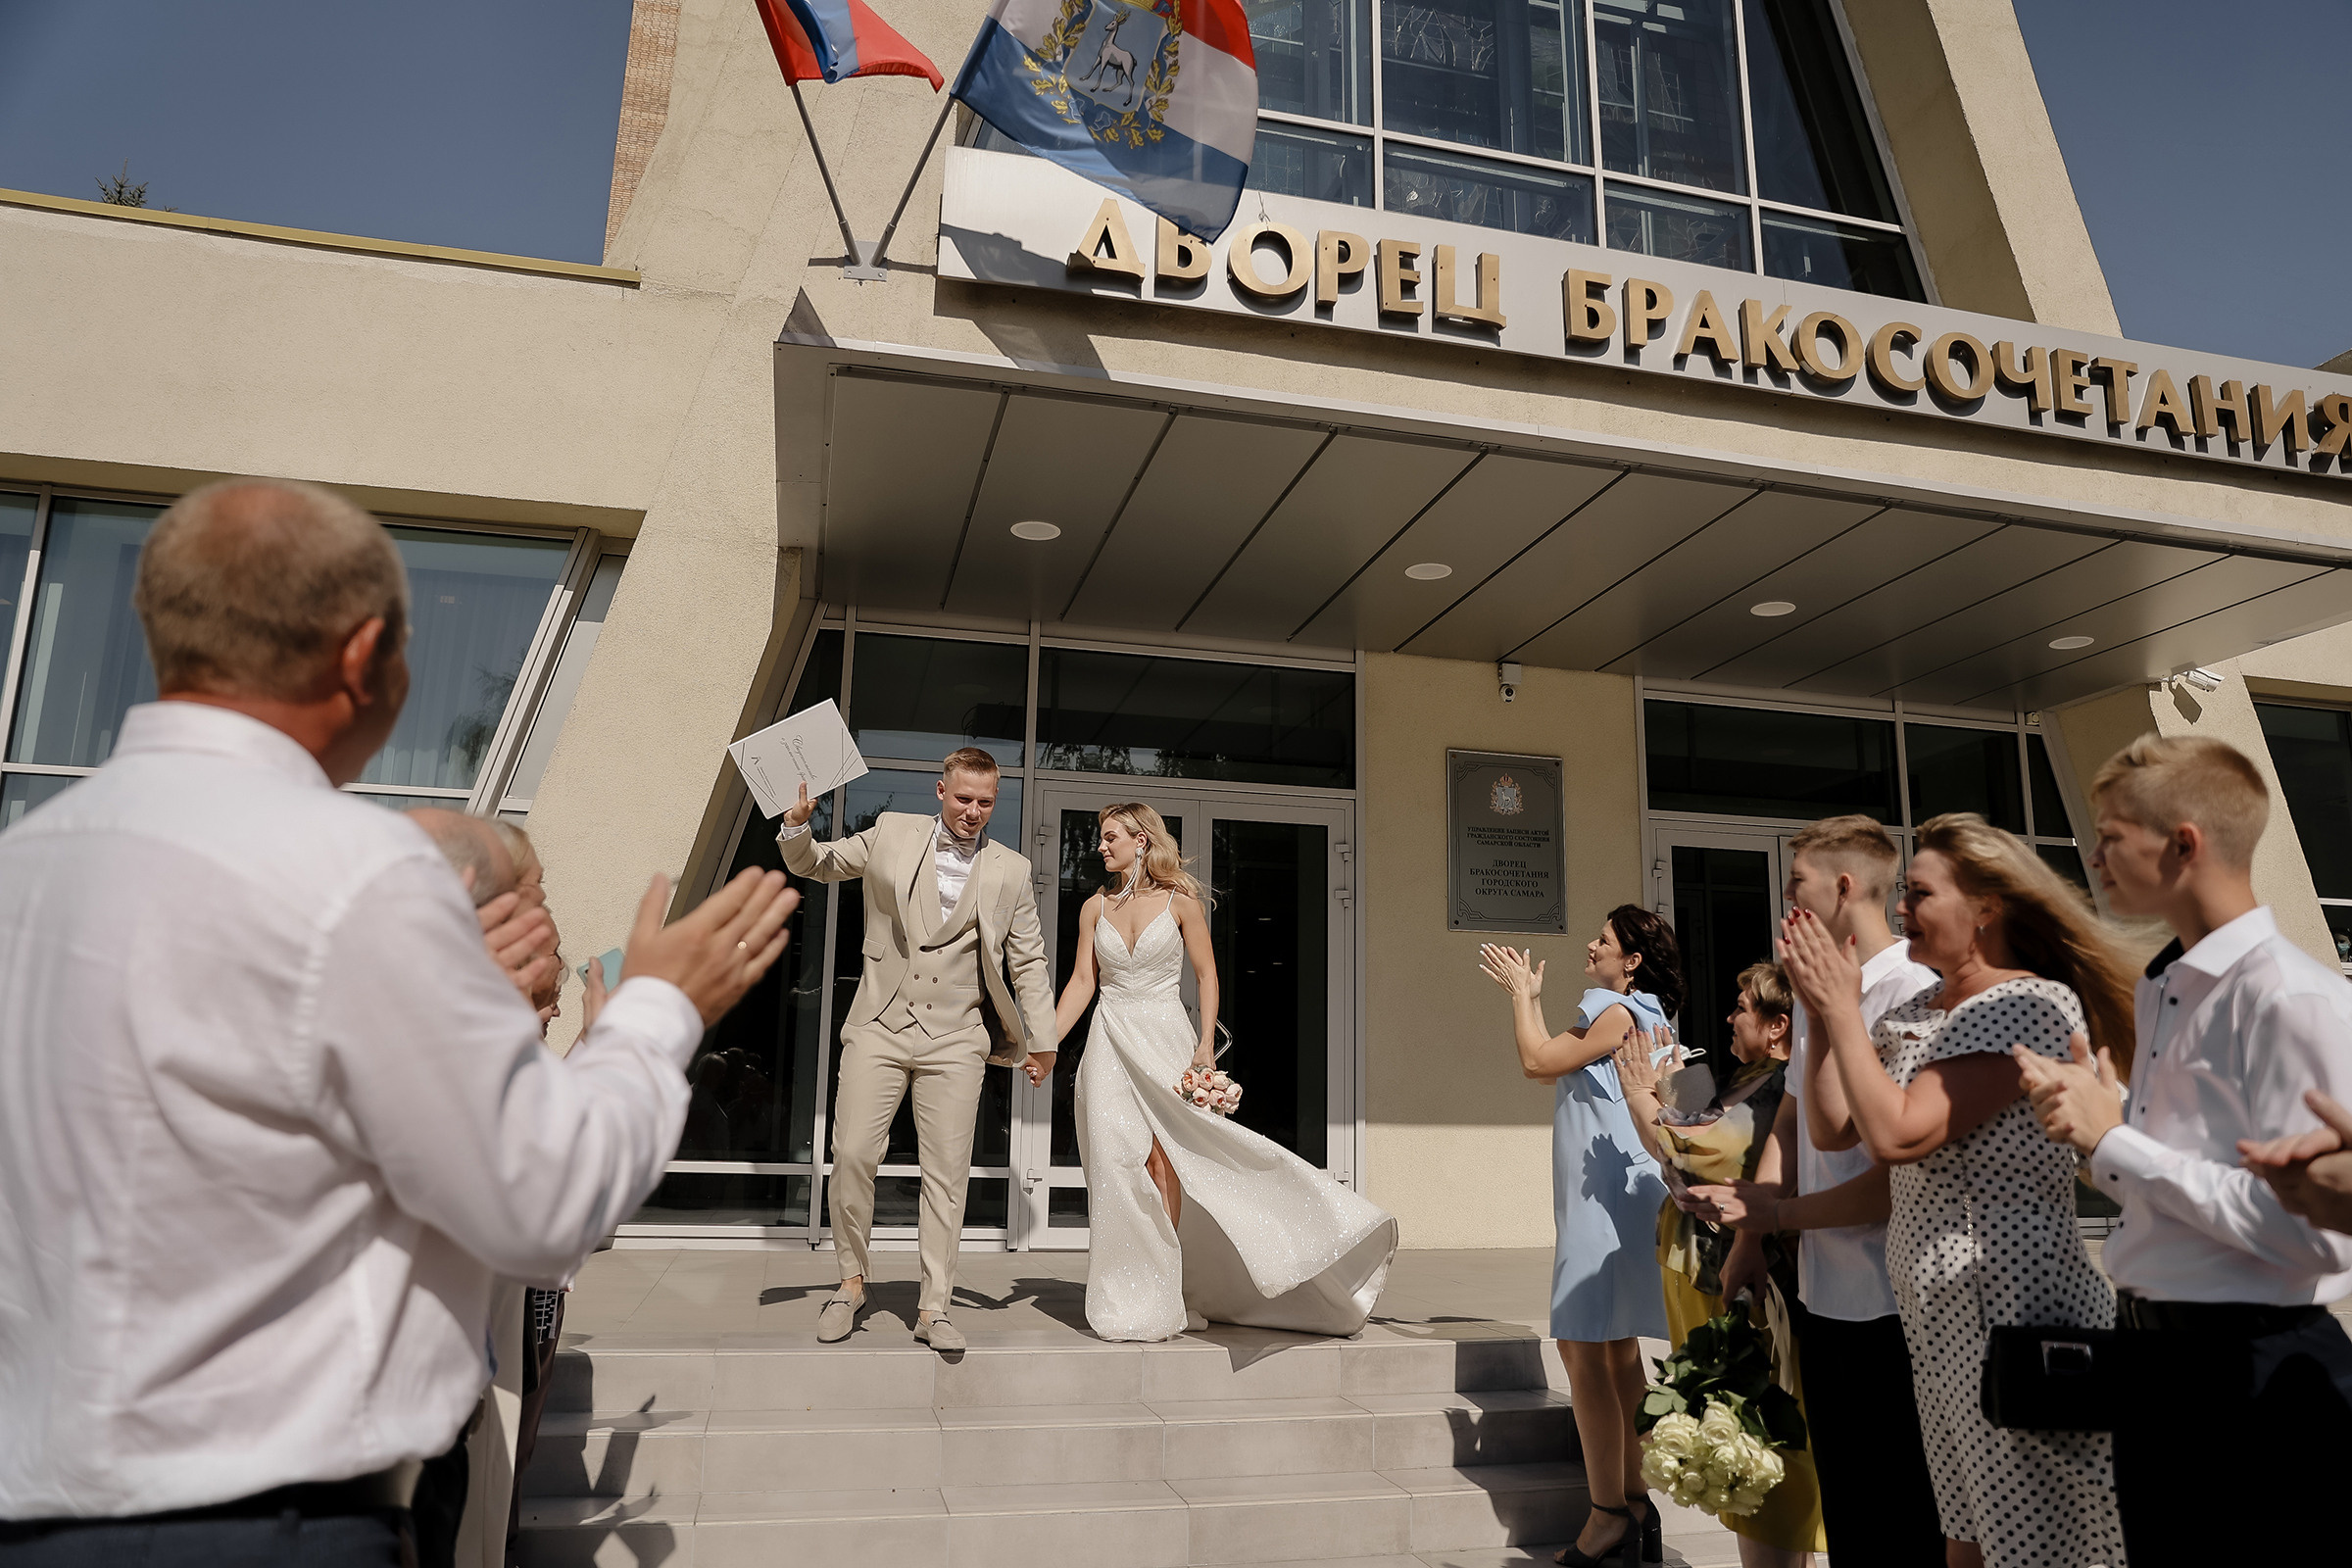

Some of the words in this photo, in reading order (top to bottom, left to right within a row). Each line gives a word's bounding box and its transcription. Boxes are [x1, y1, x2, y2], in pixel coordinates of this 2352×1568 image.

[1066, 199, 1507, 331] ДВОРЕЦ
[1562, 268, 2352, 458] БРАКОСОЧЕТАНИЯ
[1493, 859, 1527, 869] ДВОРЕЦ
[1469, 868, 1549, 879] БРАКОСОЧЕТАНИЯ
[1482, 878, 1539, 887] ГОРОДСКОГО
[1475, 887, 1509, 897] ОКРУГА
[1510, 888, 1544, 898] САМАРА
